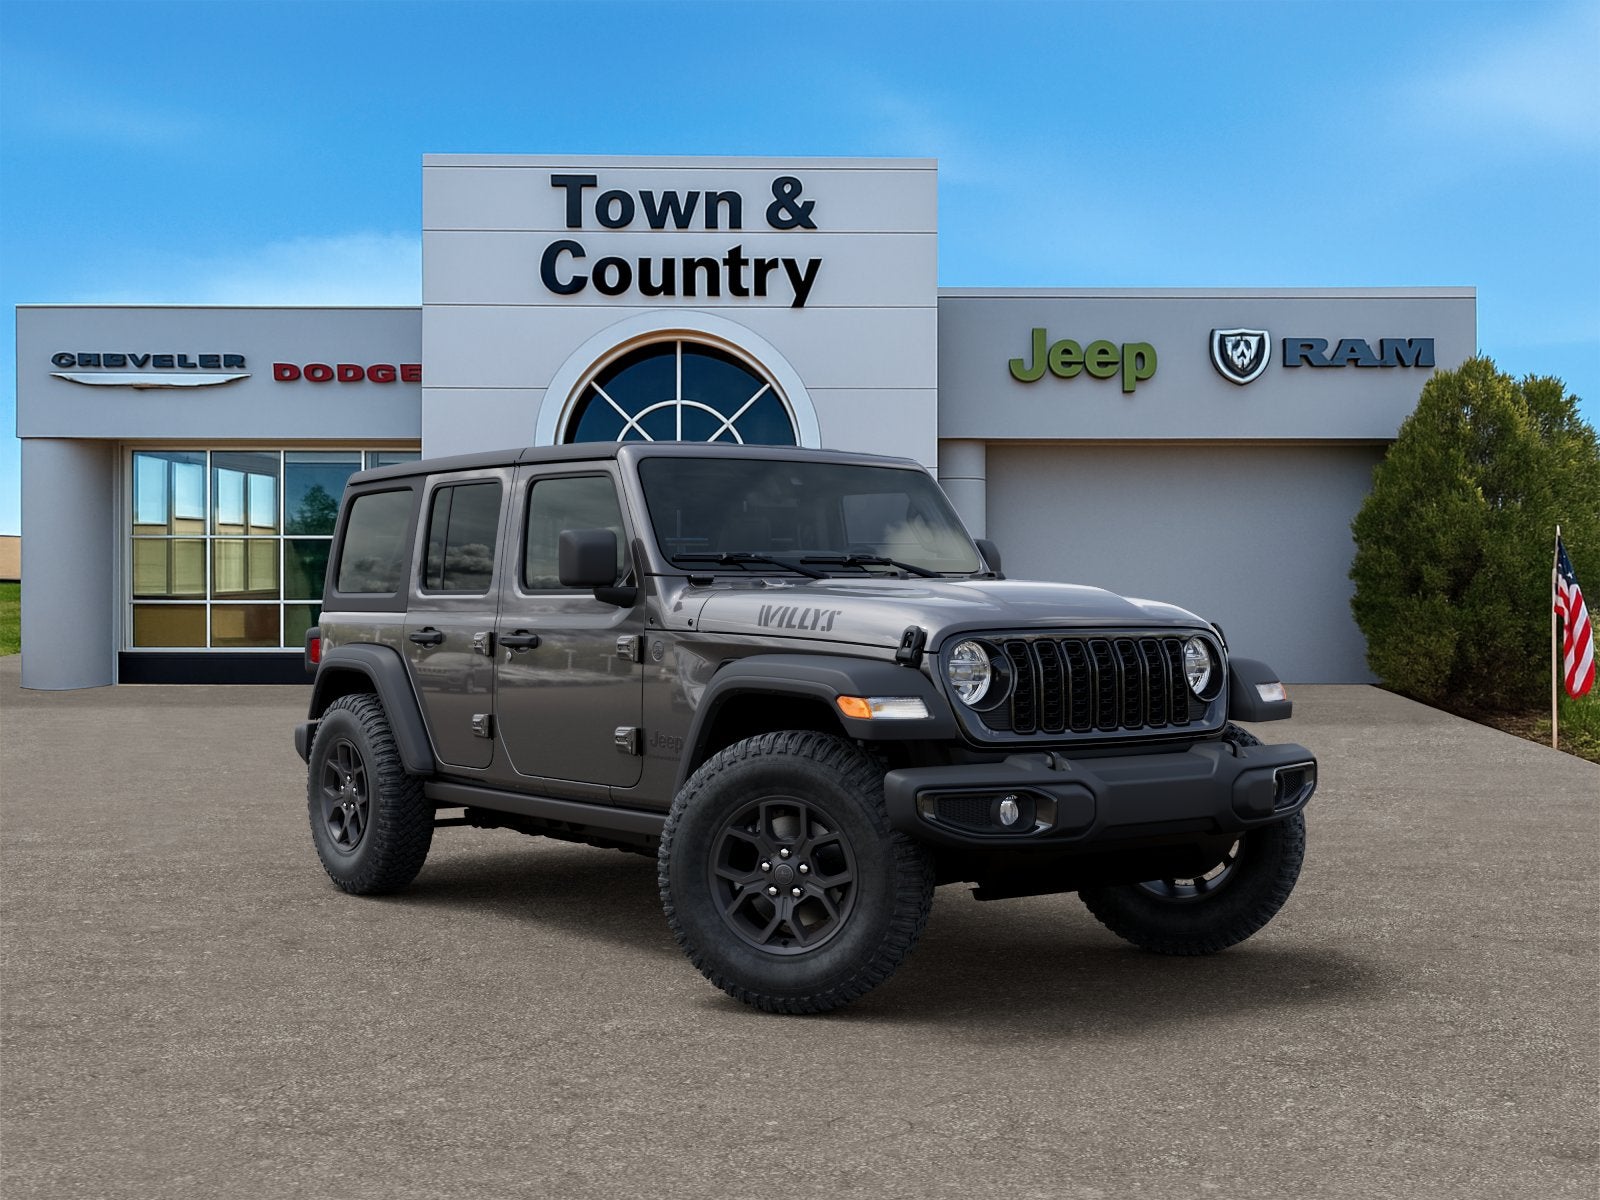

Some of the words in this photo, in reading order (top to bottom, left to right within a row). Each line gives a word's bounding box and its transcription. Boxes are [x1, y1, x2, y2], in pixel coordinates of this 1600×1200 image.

[550, 174, 743, 230] Town
[765, 176, 818, 230] &
[540, 239, 822, 308] Country
[1008, 327, 1158, 393] Jeep
[1282, 337, 1436, 368] RAM
[273, 362, 422, 383] DODGE
[757, 604, 842, 632] WILLYS
[649, 729, 684, 754] Jeep
